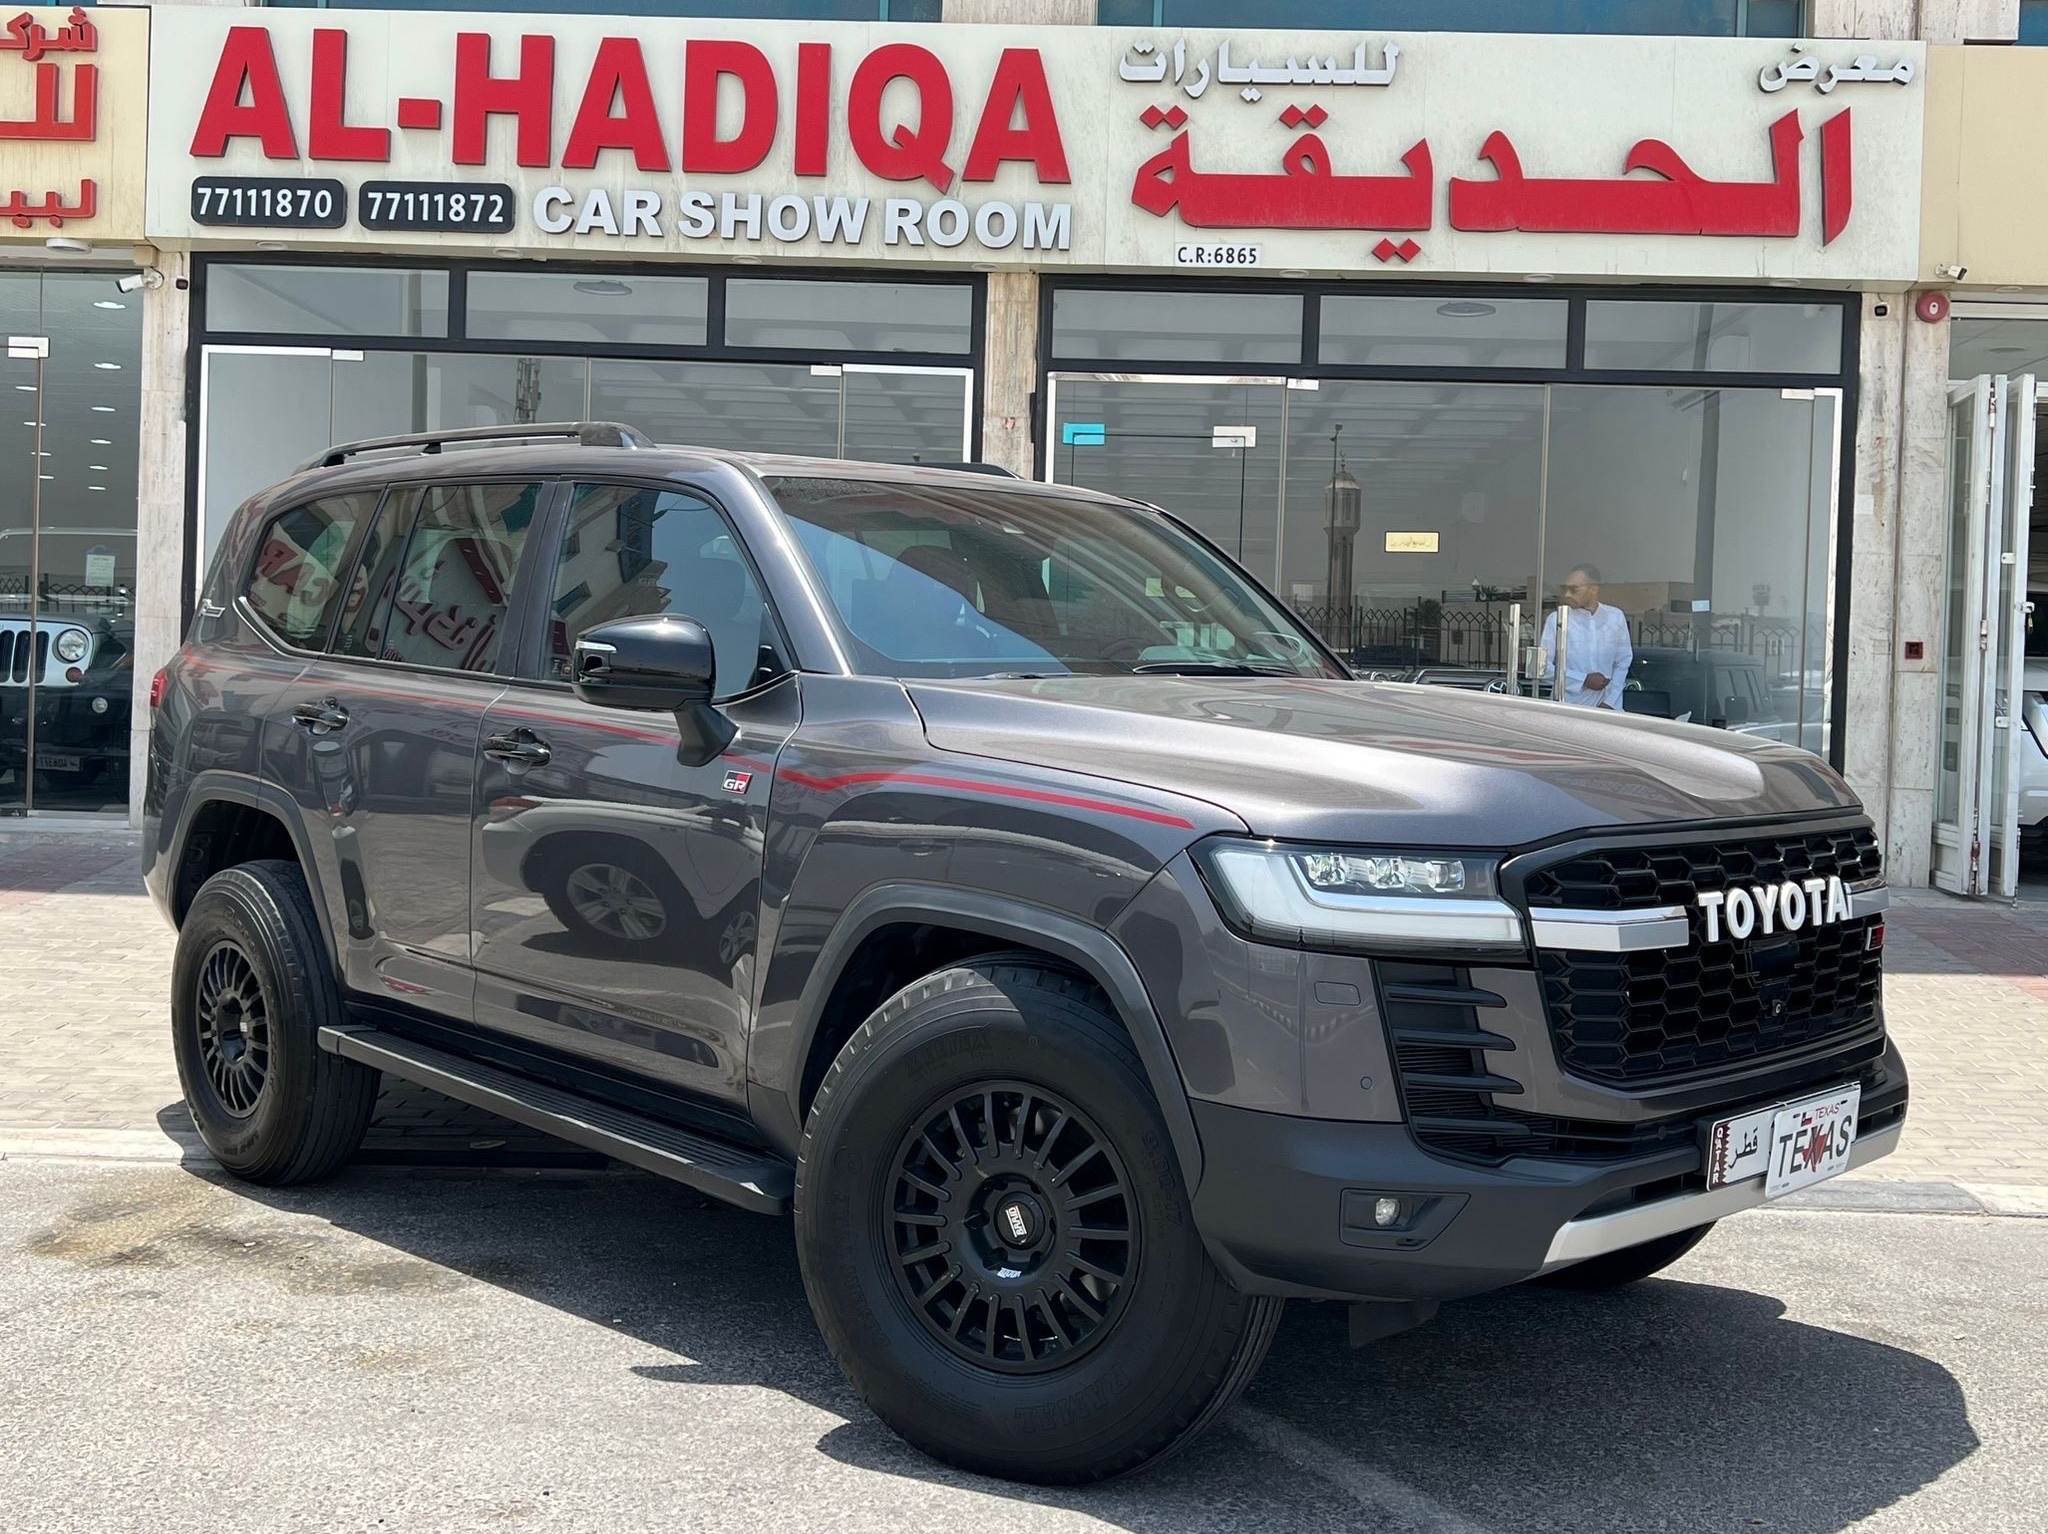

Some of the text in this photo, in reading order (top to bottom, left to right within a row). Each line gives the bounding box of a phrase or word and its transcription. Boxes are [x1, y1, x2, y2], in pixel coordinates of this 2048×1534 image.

[0, 6, 98, 62] شرك
[1118, 38, 1401, 102] للسيارات
[1758, 42, 1915, 95] معرض
[190, 26, 1072, 195] AL-HADIQA
[197, 186, 333, 220] 77111870
[367, 190, 504, 224] 77111872
[1131, 103, 1853, 263] الحديقة
[532, 186, 1072, 252] CAR SHOW ROOM
[1177, 246, 1258, 265] C.R:6865
[722, 777, 747, 791] GR
[1698, 875, 1848, 943] TOYOTA
[1814, 1102, 1841, 1120] TEXAS
[1712, 1126, 1724, 1184] QATAR
[1728, 1126, 1759, 1169] قطر
[1778, 1115, 1852, 1179] TEXAS
[1008, 1205, 1026, 1236] BRAID
